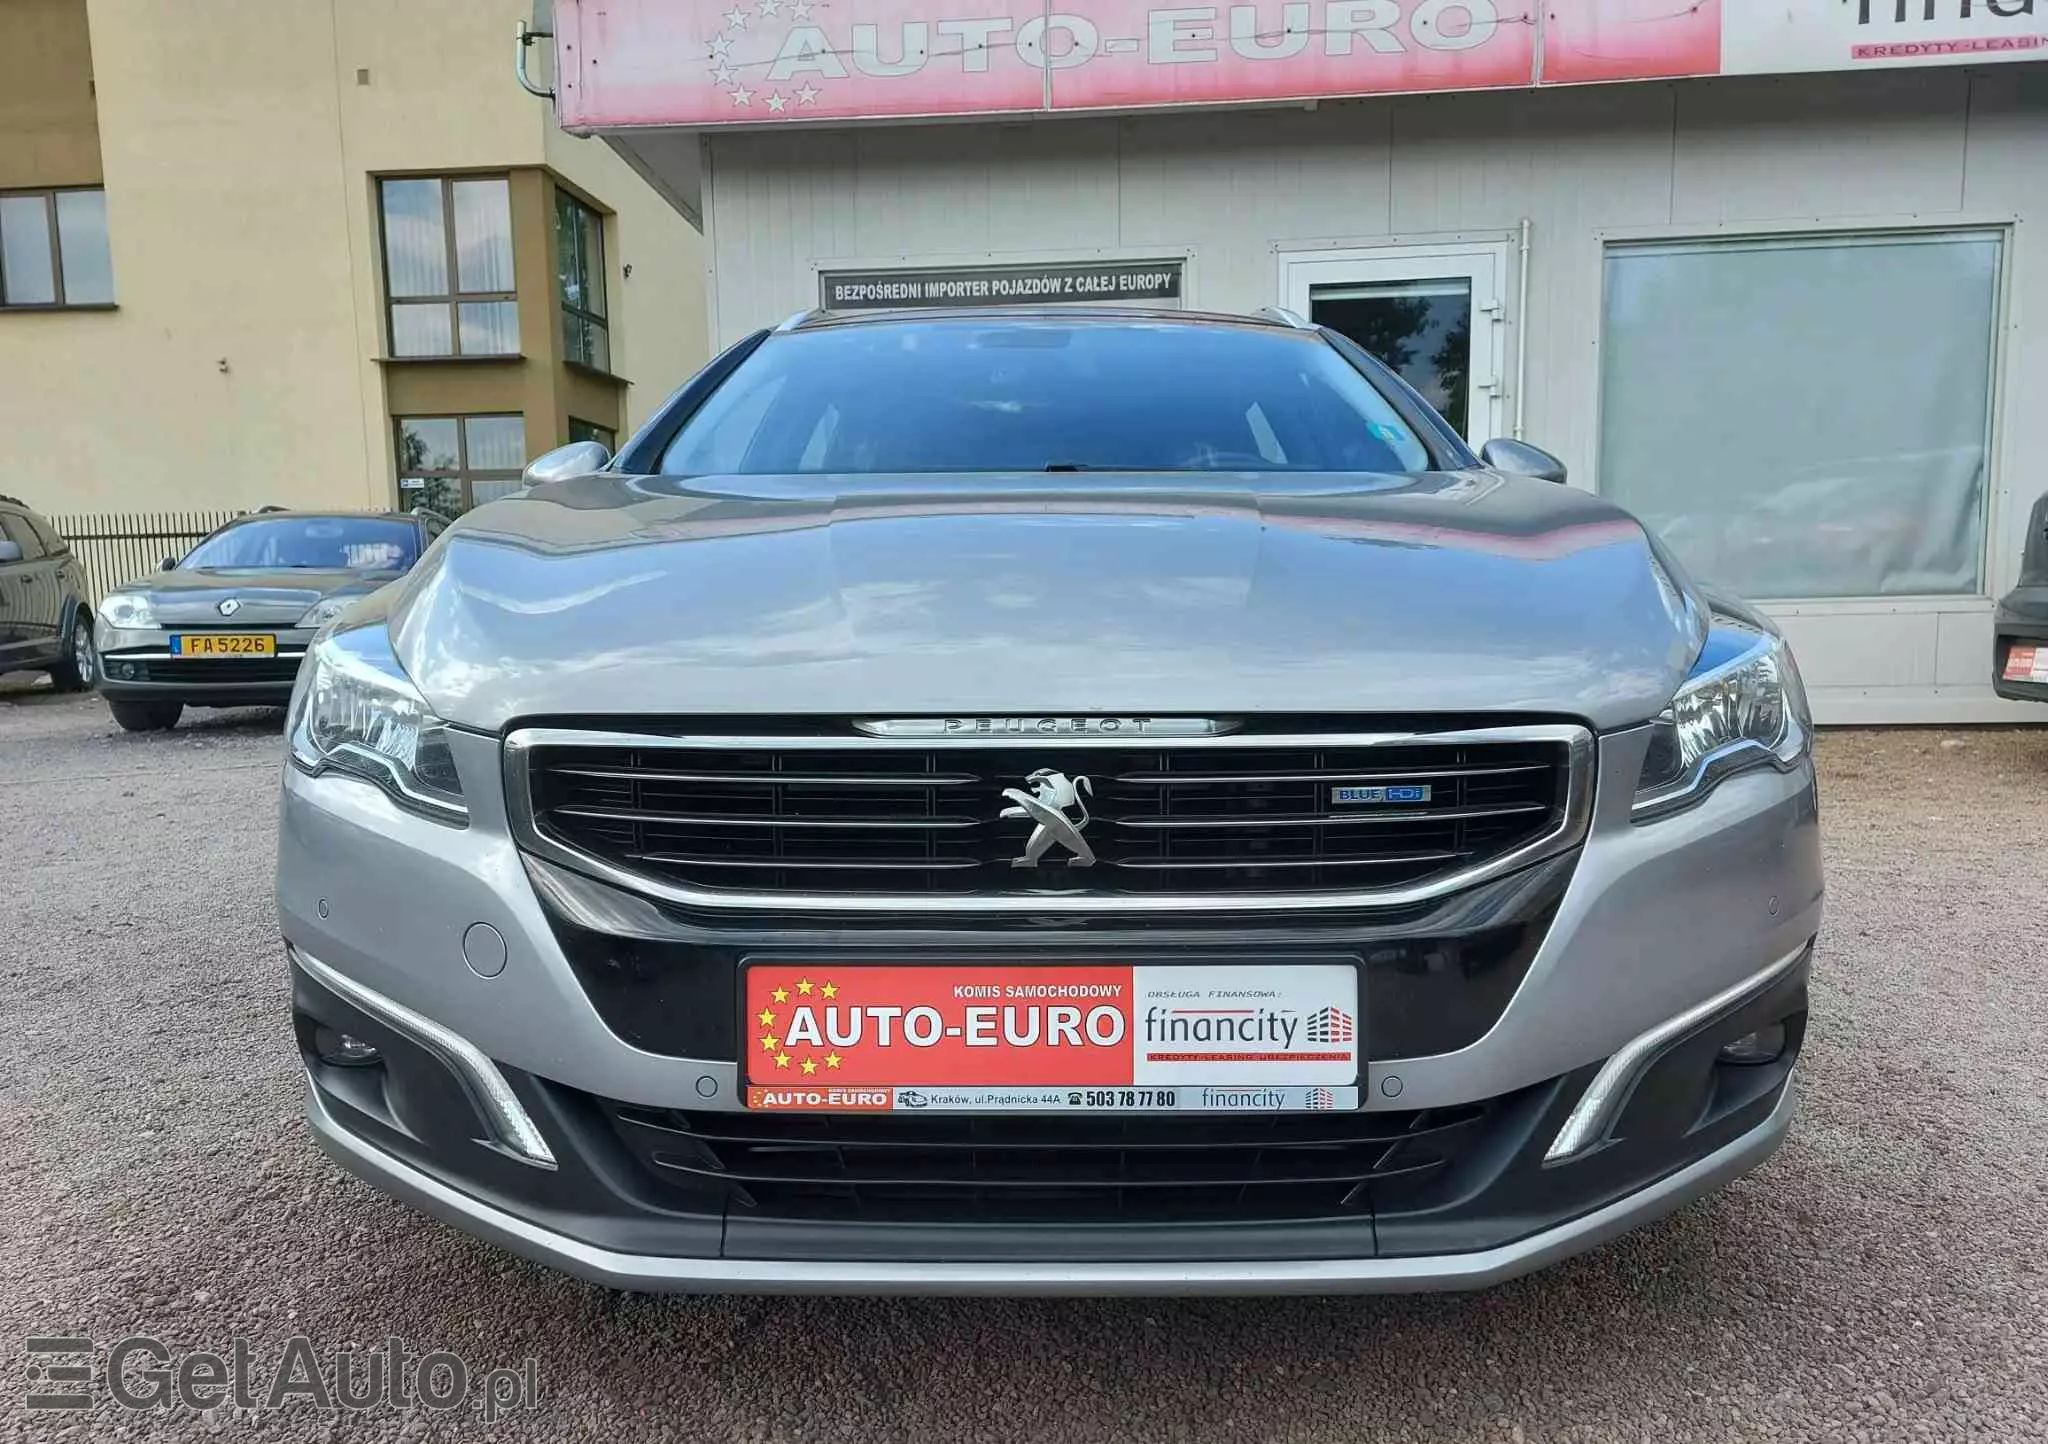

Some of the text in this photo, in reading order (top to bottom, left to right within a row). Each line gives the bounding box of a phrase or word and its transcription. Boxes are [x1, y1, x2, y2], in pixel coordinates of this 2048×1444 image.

[766, 0, 1498, 82] AUTO-EURO
[835, 273, 1172, 301] BEZPOŚREDNI IMPORTER POJAZDÓW Z CAŁEJ EUROPY
[218, 637, 265, 653] 5226
[944, 717, 1152, 734] PEUGEOT
[953, 985, 1123, 998] KOMIS SAMOCHODOWY
[782, 1004, 1126, 1048] AUTO-EURO
[1145, 1006, 1299, 1050] financity
[762, 1093, 887, 1105] AUTO-EURO
[930, 1094, 972, 1106] Kraków,
[1040, 1094, 1061, 1105] 44A
[1086, 1090, 1115, 1106] 503
[1118, 1090, 1136, 1106] 78
[1138, 1090, 1154, 1106] 77
[1156, 1090, 1176, 1106] 80
[1202, 1088, 1286, 1110] financity
